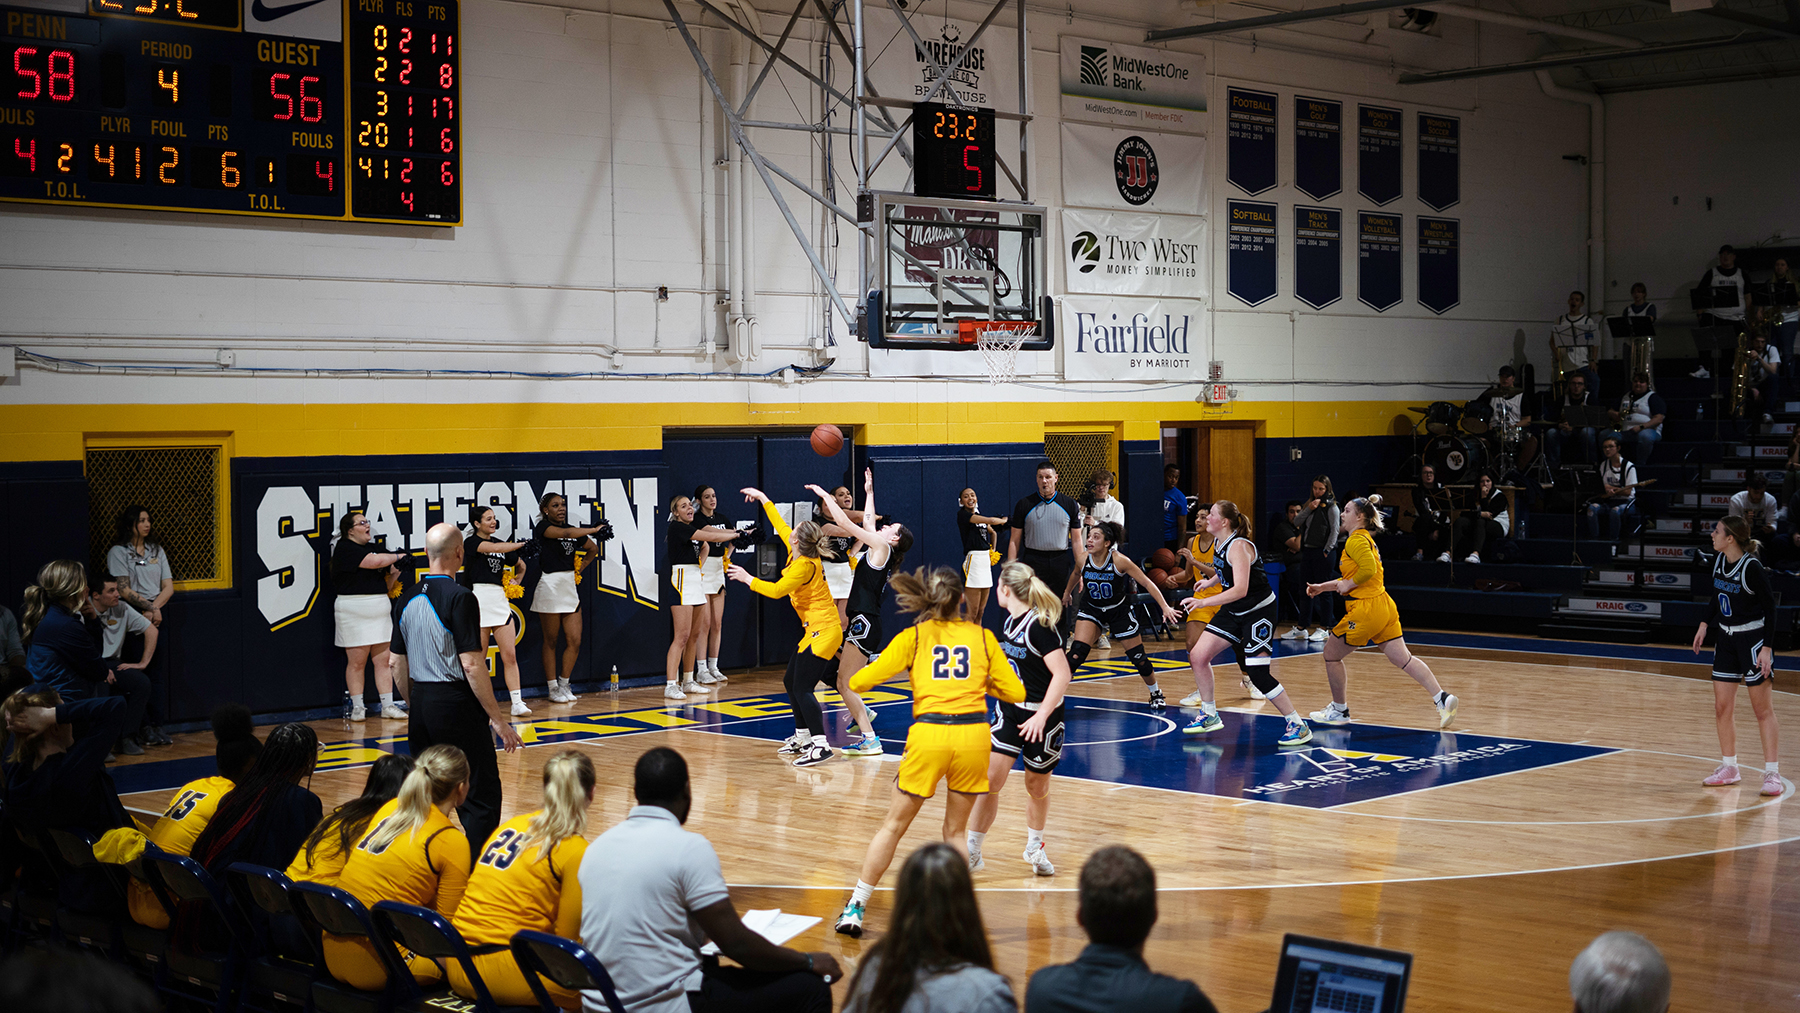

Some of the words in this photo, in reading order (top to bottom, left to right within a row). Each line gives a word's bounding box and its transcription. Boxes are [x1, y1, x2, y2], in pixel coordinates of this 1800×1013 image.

[359, 0, 384, 14] PLYR
[396, 1, 413, 17] FLS
[428, 5, 446, 21] PTS
[7, 11, 67, 40] PENN
[141, 40, 193, 60] PERIOD
[257, 39, 321, 67] GUEST
[374, 24, 388, 51] 0
[399, 27, 413, 54] 2
[431, 33, 453, 56] 11
[14, 47, 75, 101] 58
[374, 56, 388, 82] 2
[399, 59, 413, 85] 2
[439, 63, 453, 89] 8
[1113, 55, 1189, 80] MidWestOne
[158, 69, 179, 103] 4
[270, 72, 323, 123] 56
[377, 90, 388, 116] 3
[408, 95, 413, 117] 1
[432, 96, 453, 120] 17
[946, 104, 979, 112] DAKTRONICS
[1085, 104, 1138, 117] MidWestOne.com
[1145, 111, 1169, 122] Member
[1170, 114, 1183, 123] FDIC
[101, 116, 131, 133] PLYR
[151, 120, 187, 138] FOUL
[208, 124, 229, 141] PTS
[358, 121, 388, 148] 20
[408, 127, 413, 148] 1
[440, 128, 453, 153] 6
[934, 111, 977, 141] 23.2
[292, 131, 334, 149] FOULS
[15, 138, 36, 172] 4
[57, 143, 73, 172] 2
[94, 144, 141, 179] 41
[159, 146, 179, 184] 2
[963, 145, 982, 191] 5
[1117, 141, 1134, 164] JIMMY
[1136, 141, 1155, 168] JOHN'S
[221, 151, 241, 188] 6
[268, 161, 274, 183] 1
[315, 160, 333, 192] 4
[358, 157, 389, 180] 41
[401, 158, 413, 184] 2
[441, 161, 453, 186] 6
[1126, 155, 1148, 188] JJ
[44, 181, 87, 199] T.O.L.
[248, 194, 286, 210] T.O.L.
[401, 191, 413, 213] 4
[1233, 208, 1272, 222] SOFTBALL
[1107, 265, 1139, 275] MONEY
[1145, 266, 1196, 277] SIMPLIFIED
[1075, 312, 1190, 354] Fairfield
[1130, 359, 1141, 368] BY
[1146, 359, 1190, 368] MARRIOTT
[1214, 385, 1227, 400] EXIT
[1711, 496, 1730, 504] KRA
[1656, 548, 1683, 556] KRAIG
[1087, 581, 1115, 599] 20
[1596, 602, 1624, 610] KRAIG
[1628, 603, 1646, 611] Ford
[1718, 592, 1733, 617] 0
[932, 645, 971, 680] 23
[1243, 771, 1352, 793] HEART
[1391, 743, 1524, 769] AMERICA
[161, 788, 209, 822] 15
[479, 827, 534, 871] 25
